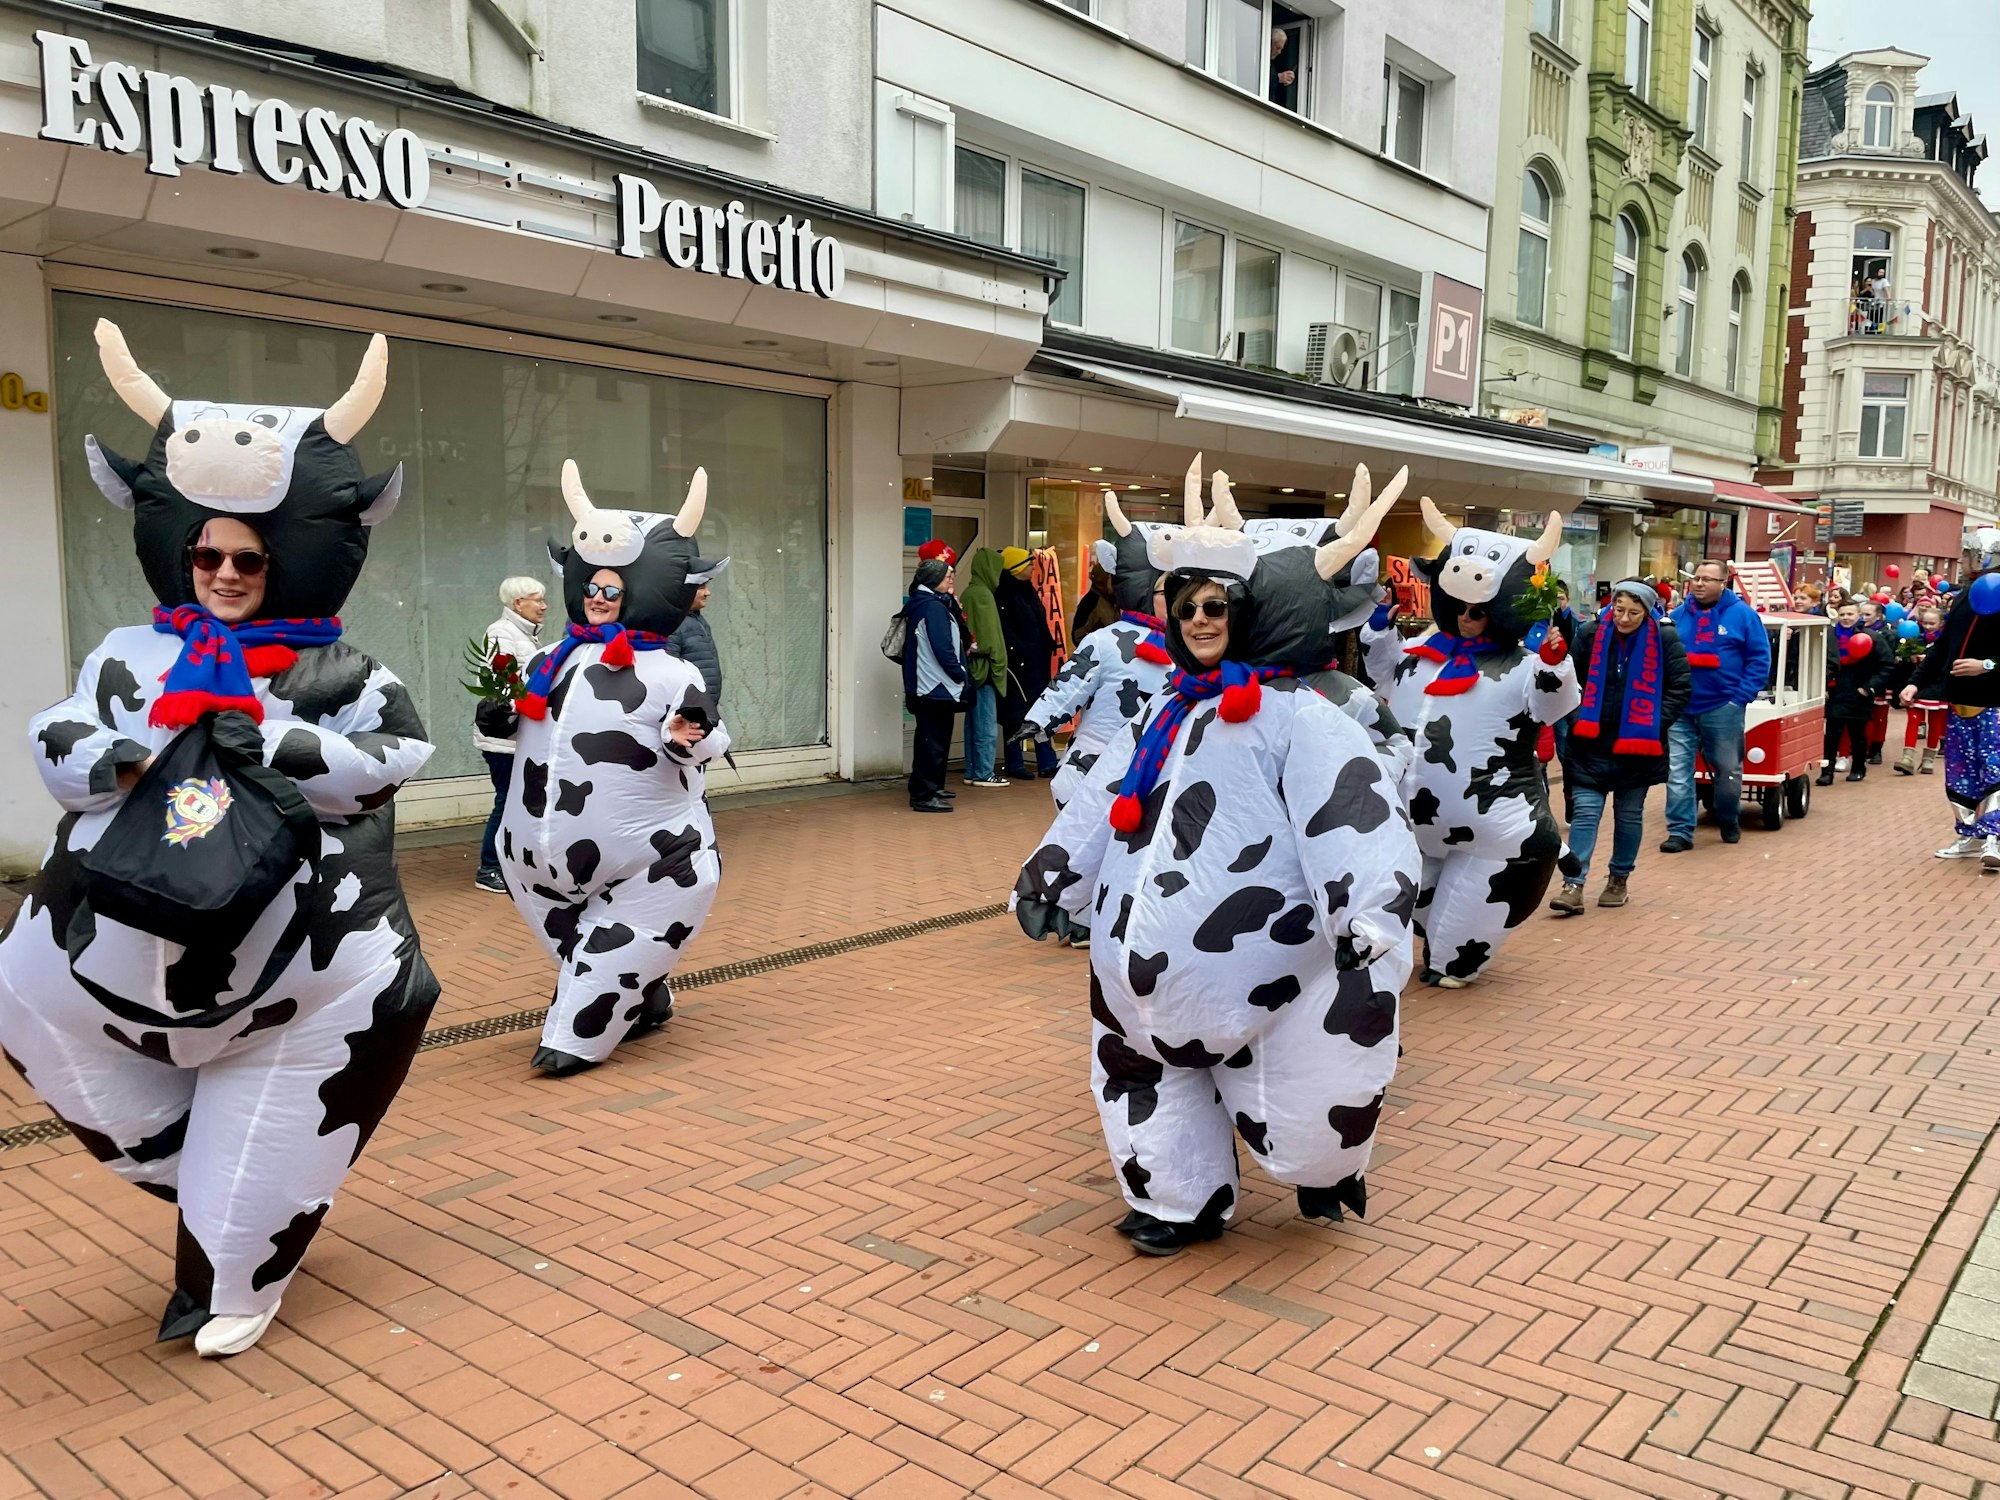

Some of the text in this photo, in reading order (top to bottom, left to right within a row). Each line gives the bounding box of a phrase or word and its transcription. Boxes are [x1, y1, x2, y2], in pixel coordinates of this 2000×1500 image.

[35, 29, 845, 298] Espresso Perfetto
[1436, 311, 1469, 373] P1
[903, 477, 932, 502] 20a
[1628, 697, 1654, 727] KG
